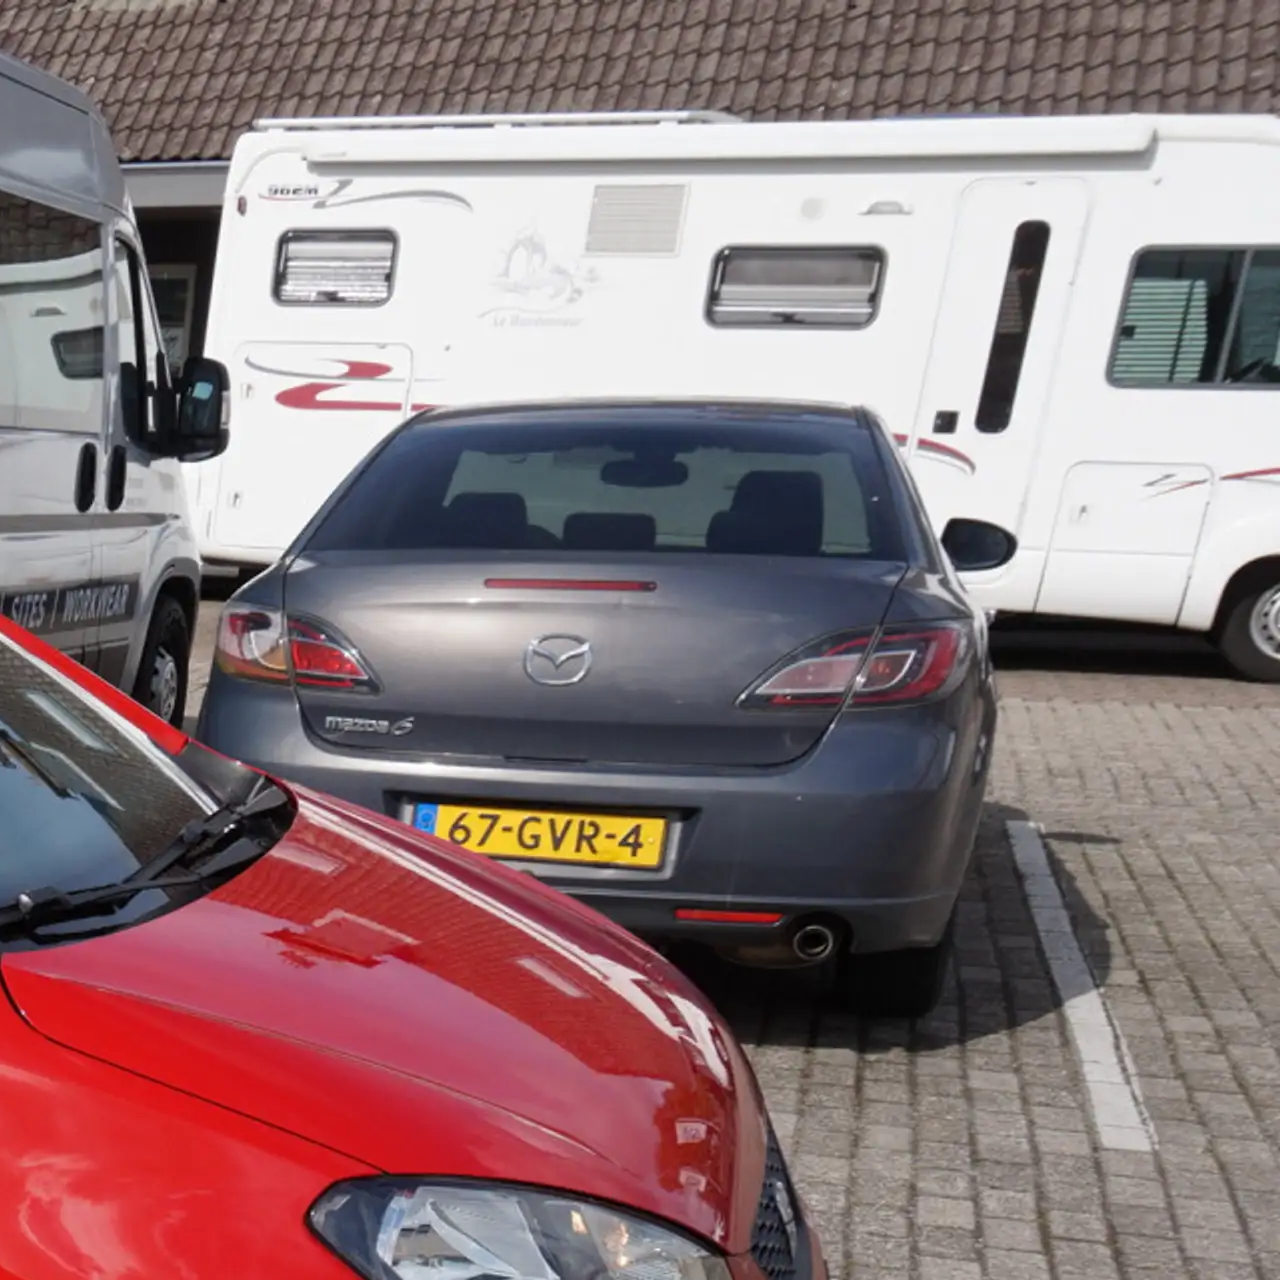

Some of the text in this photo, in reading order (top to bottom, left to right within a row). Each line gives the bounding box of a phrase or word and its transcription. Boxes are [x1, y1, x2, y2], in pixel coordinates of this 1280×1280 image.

[11, 592, 47, 628] SITES
[62, 584, 130, 624] WORKWEAR
[391, 716, 415, 736] 6
[447, 811, 645, 858] 67-GVR-4
